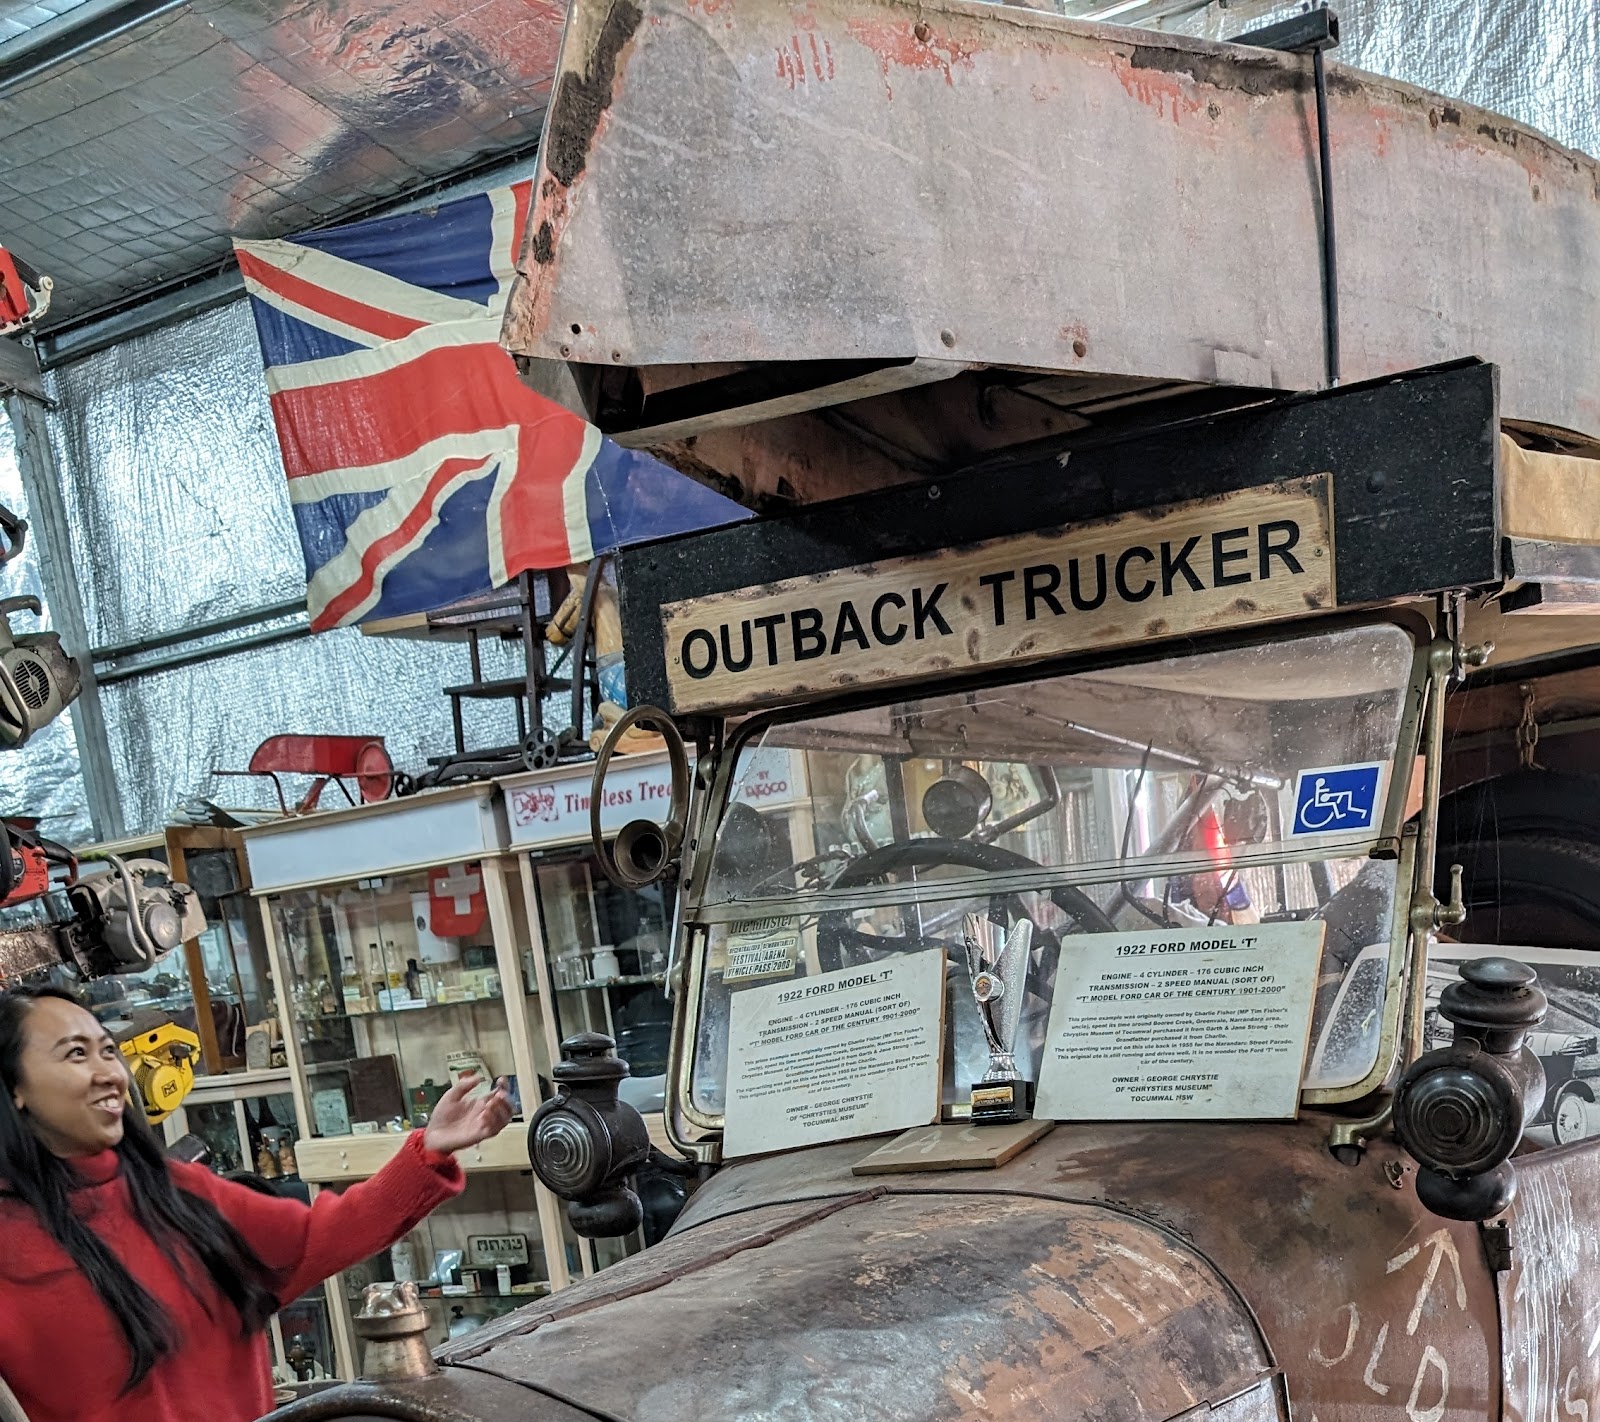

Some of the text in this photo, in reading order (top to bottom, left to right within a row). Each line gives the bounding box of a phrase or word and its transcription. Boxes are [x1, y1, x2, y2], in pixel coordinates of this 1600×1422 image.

[681, 519, 1306, 679] OUTBACK TRUCKER
[564, 788, 632, 813] Timless
[1115, 944, 1146, 956] 1922
[1149, 942, 1186, 954] FORD
[1189, 938, 1237, 951] MODEL
[733, 949, 786, 966] FESTIVAL ARENA
[727, 965, 753, 977] VEHICLE
[754, 962, 771, 973] PASS
[1100, 972, 1132, 980] ENGINE
[1146, 968, 1188, 978] CYLINDER
[1196, 967, 1211, 975] 176
[1212, 966, 1240, 974] CUBIC
[1241, 964, 1264, 973] INCH
[778, 988, 802, 1002] 1922
[805, 982, 835, 996] FORD
[838, 973, 876, 990] MODEL
[1088, 981, 1149, 992] TRANSMISSION
[1164, 979, 1191, 988] SPEED
[1192, 977, 1229, 986] MANUAL
[1230, 976, 1258, 984] (SORT
[1259, 975, 1275, 983] OF)
[1090, 993, 1118, 1001] MODEL
[1119, 992, 1142, 1000] FORD
[1143, 991, 1161, 999] CAR
[1162, 990, 1174, 998] OF
[1194, 987, 1236, 996] CENTURY
[767, 1014, 793, 1025] ENGINE
[805, 1005, 839, 1018] CYLINDER
[859, 996, 881, 1007] CUBIC
[882, 992, 900, 1002] INCH
[758, 1000, 910, 1037] TRANSMISSION 2 SPEED MANUAL (SORT OF)
[760, 1034, 783, 1045] MODEL
[785, 1030, 803, 1040] FORD
[804, 1027, 819, 1036] CAR
[820, 1025, 829, 1033] OF
[831, 1022, 845, 1031] THE
[846, 1015, 879, 1028] CENTURY
[1111, 1073, 1219, 1083] OWNER GEORGE CHRYSTIE
[785, 1092, 873, 1113] OWNER GEORGE CHRYSTIE
[802, 1113, 854, 1128] TOCUMWAL NSW
